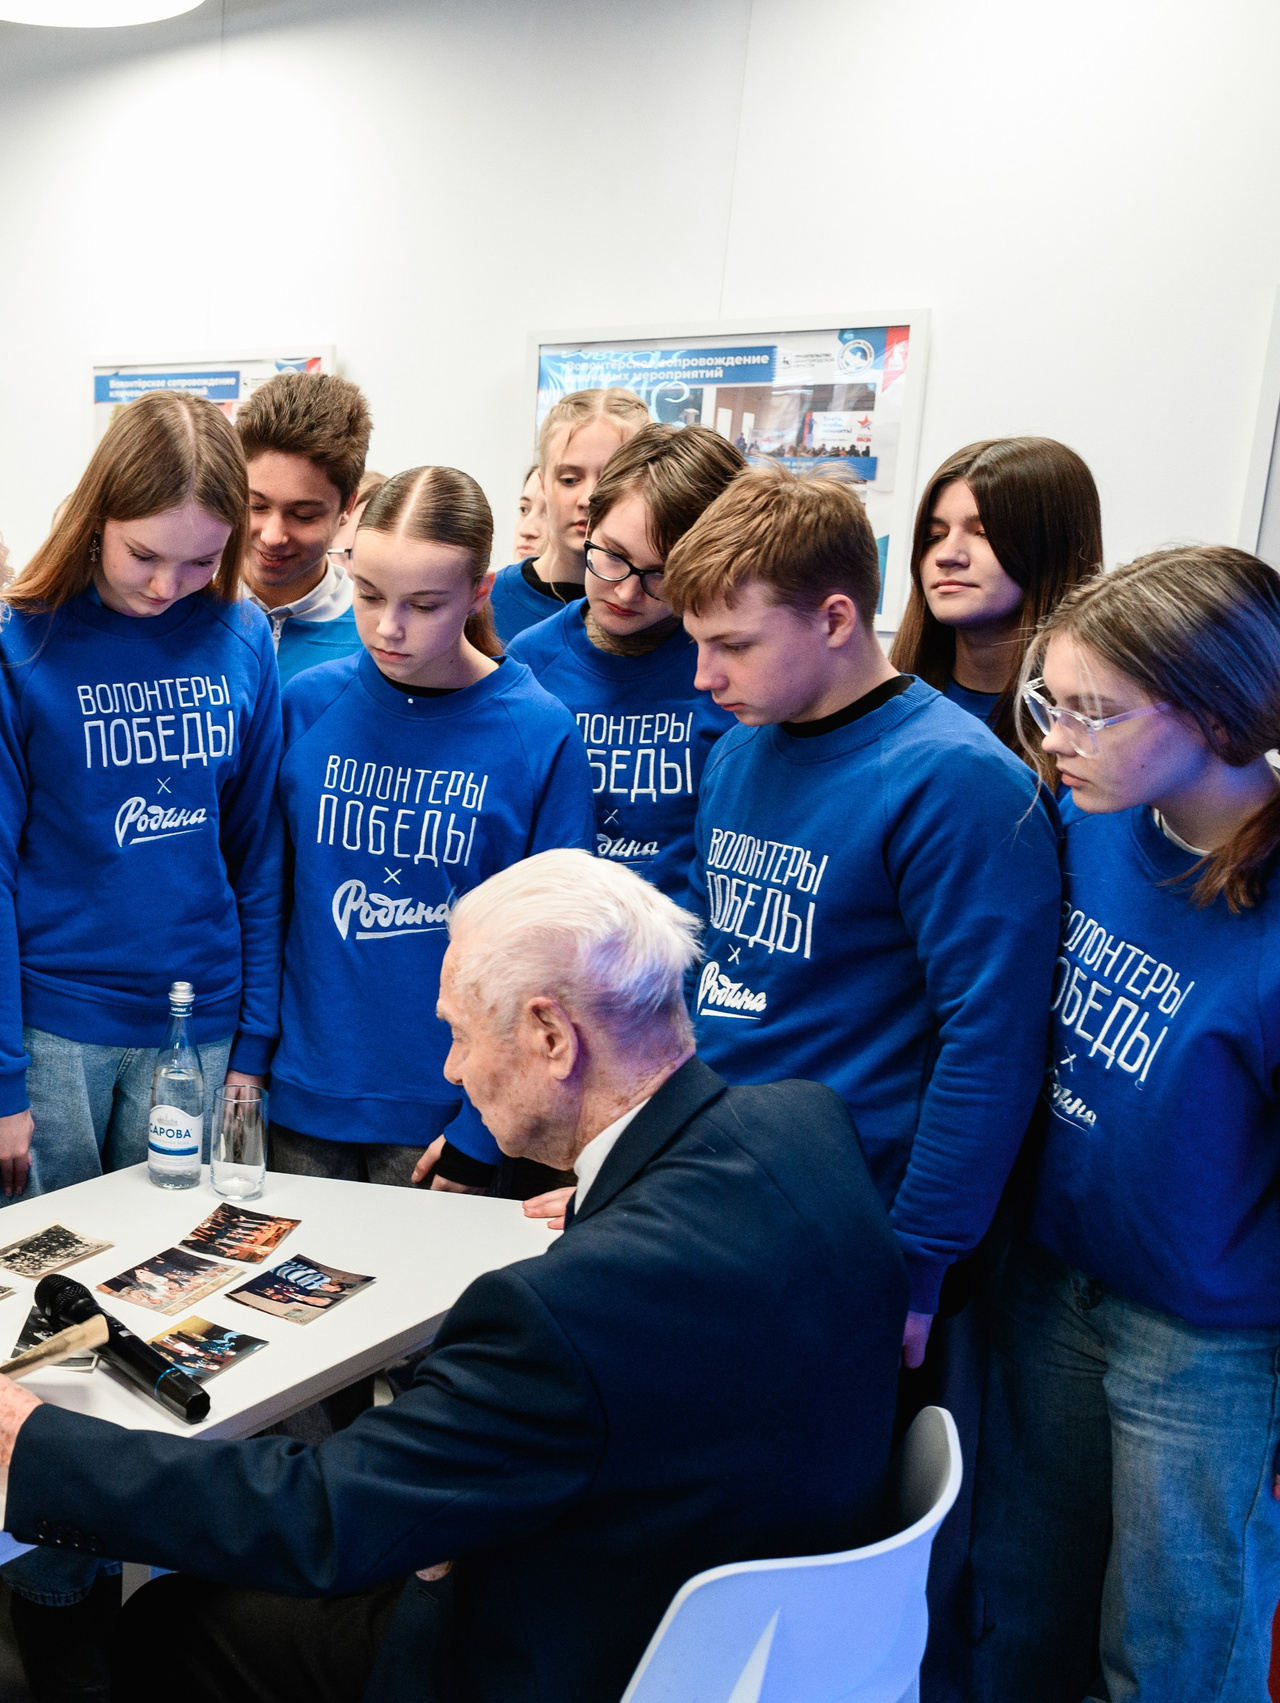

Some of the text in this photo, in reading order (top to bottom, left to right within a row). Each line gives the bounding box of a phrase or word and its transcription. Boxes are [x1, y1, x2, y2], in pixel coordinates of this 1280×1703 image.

[77, 675, 230, 715] ВОЛОНТЕРЫ
[83, 710, 234, 769] ПОБЕДЫ
[576, 711, 694, 746] ЛОНТЕРЫ
[324, 755, 489, 811] ВОЛОНТЕРЫ
[586, 748, 693, 803] БЕДЫ
[115, 796, 208, 848] Родина
[317, 794, 477, 868] ПОБЕДЫ
[707, 828, 829, 895] ВОЛОНТЕРЫ
[706, 870, 816, 959] ПОБЕДЫ
